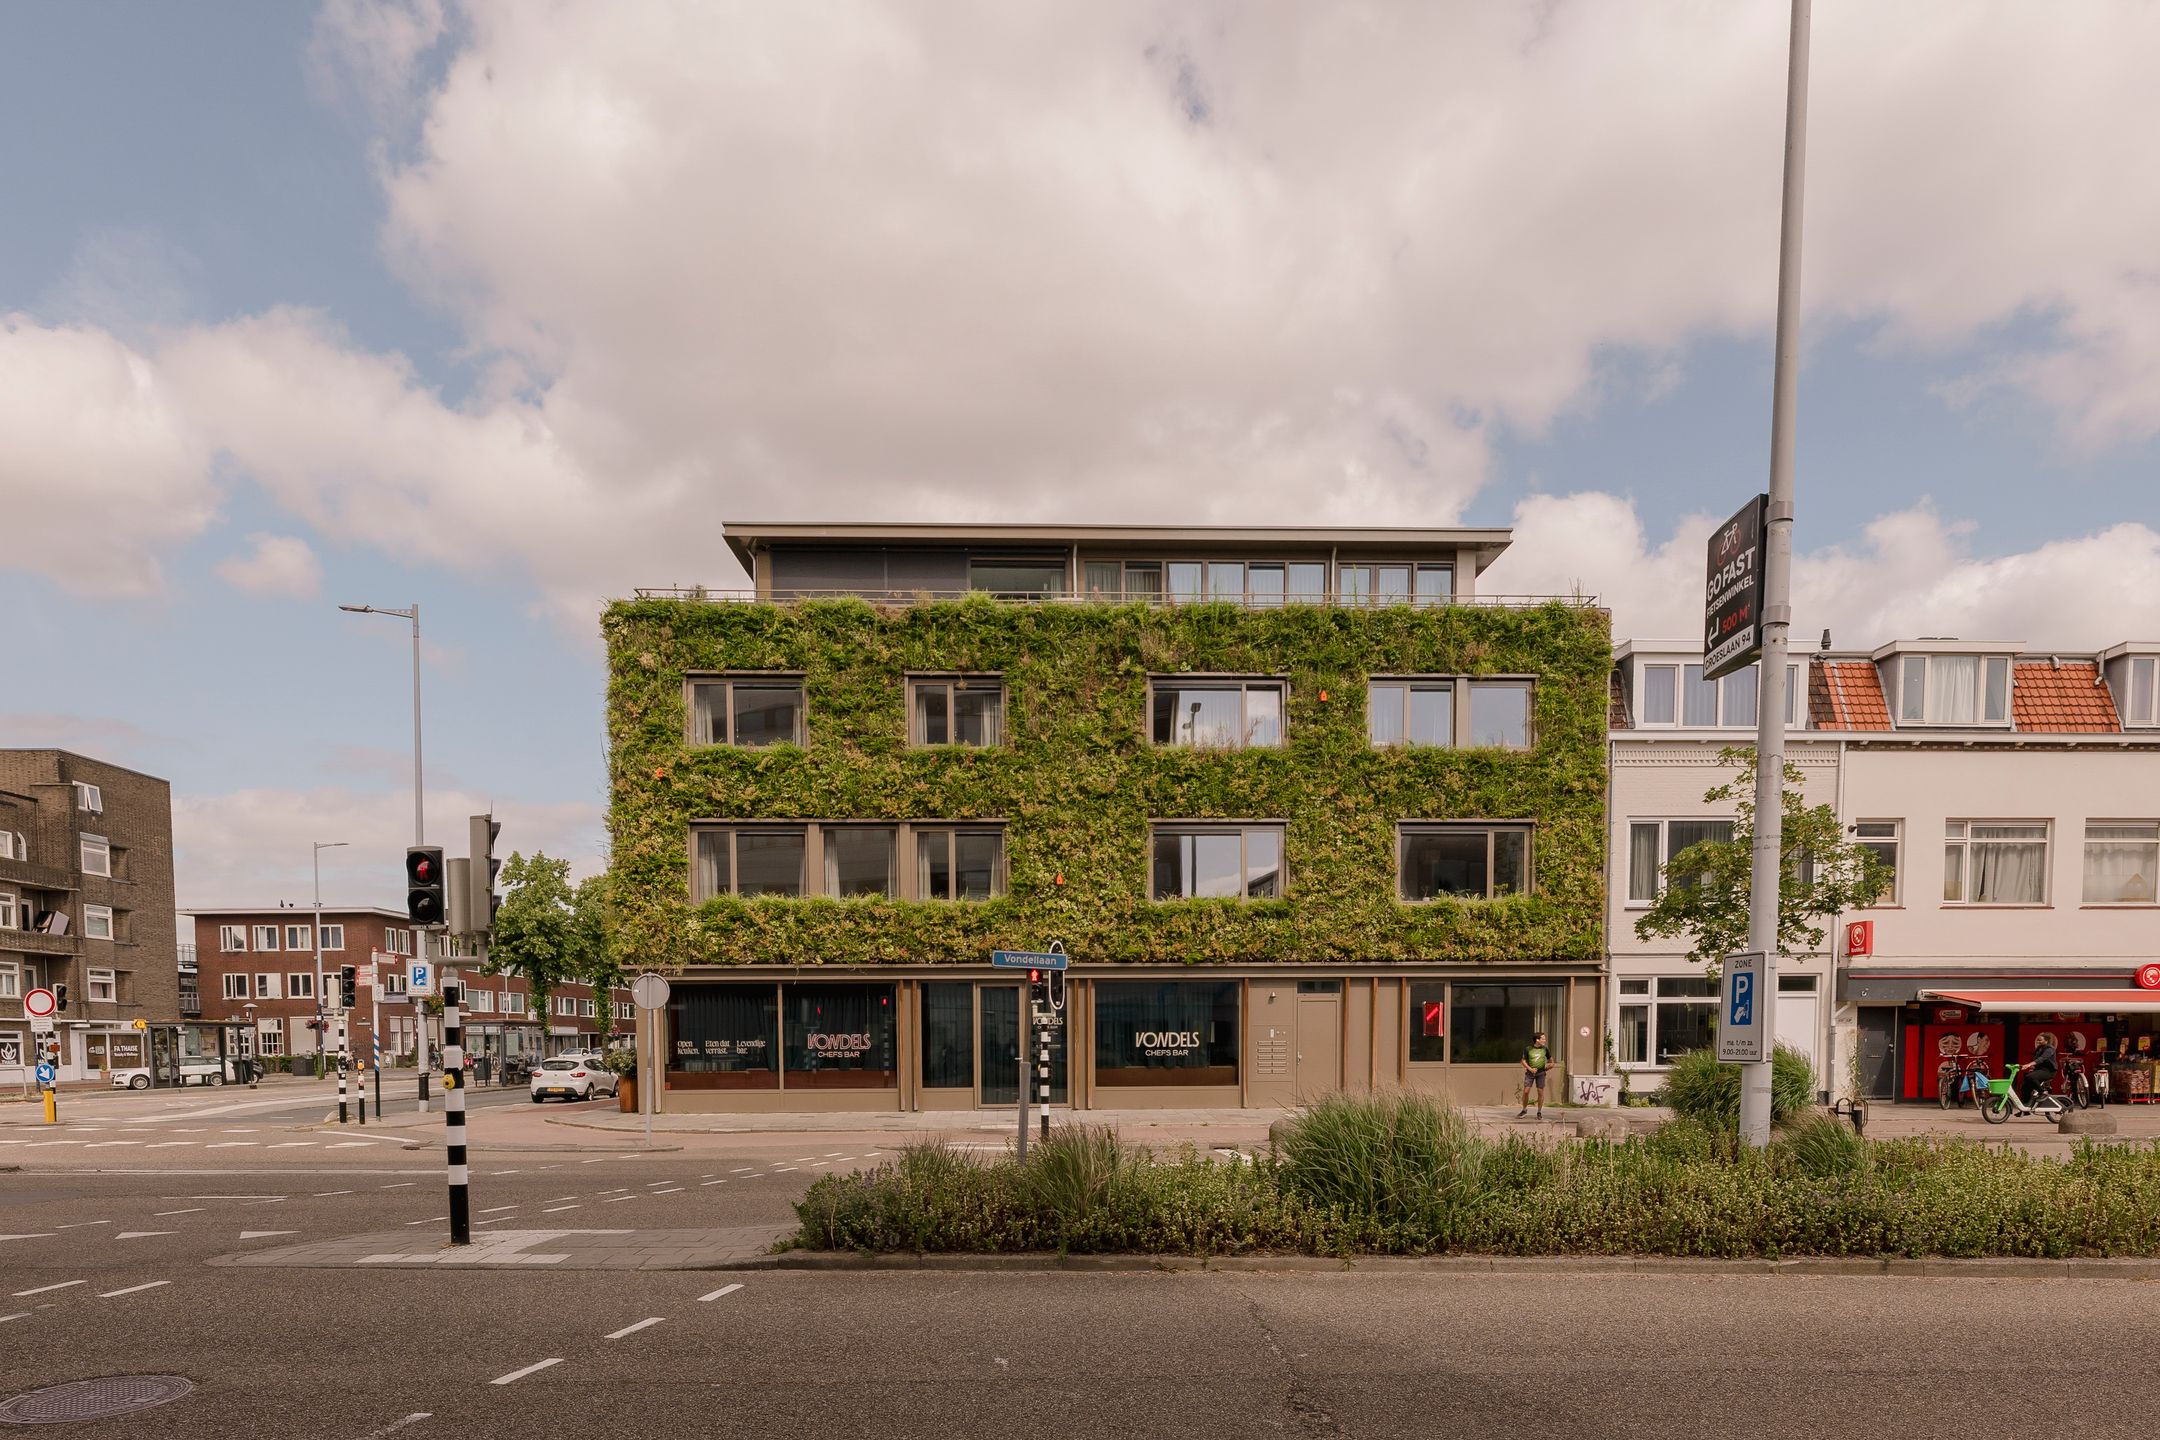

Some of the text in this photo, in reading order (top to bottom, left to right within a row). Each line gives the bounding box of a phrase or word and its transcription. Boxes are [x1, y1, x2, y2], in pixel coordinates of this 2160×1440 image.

[1707, 546, 1756, 601] GO FAST
[1706, 574, 1754, 619] FIETSENWINKEL
[1722, 612, 1737, 634] 500
[1742, 631, 1751, 646] 94
[1004, 953, 1057, 965] Vondellaan
[1734, 959, 1752, 968] ZONE
[416, 967, 424, 978] P
[1736, 976, 1748, 1004] P
[1032, 1017, 1063, 1025] VODELS
[677, 1040, 693, 1049] Open
[720, 1039, 730, 1047] dat
[736, 1040, 766, 1049] Levendige
[807, 1033, 872, 1050] VONDELS
[1135, 1031, 1200, 1048] VONDELS
[1145, 1049, 1189, 1057] CHEFS BAR
